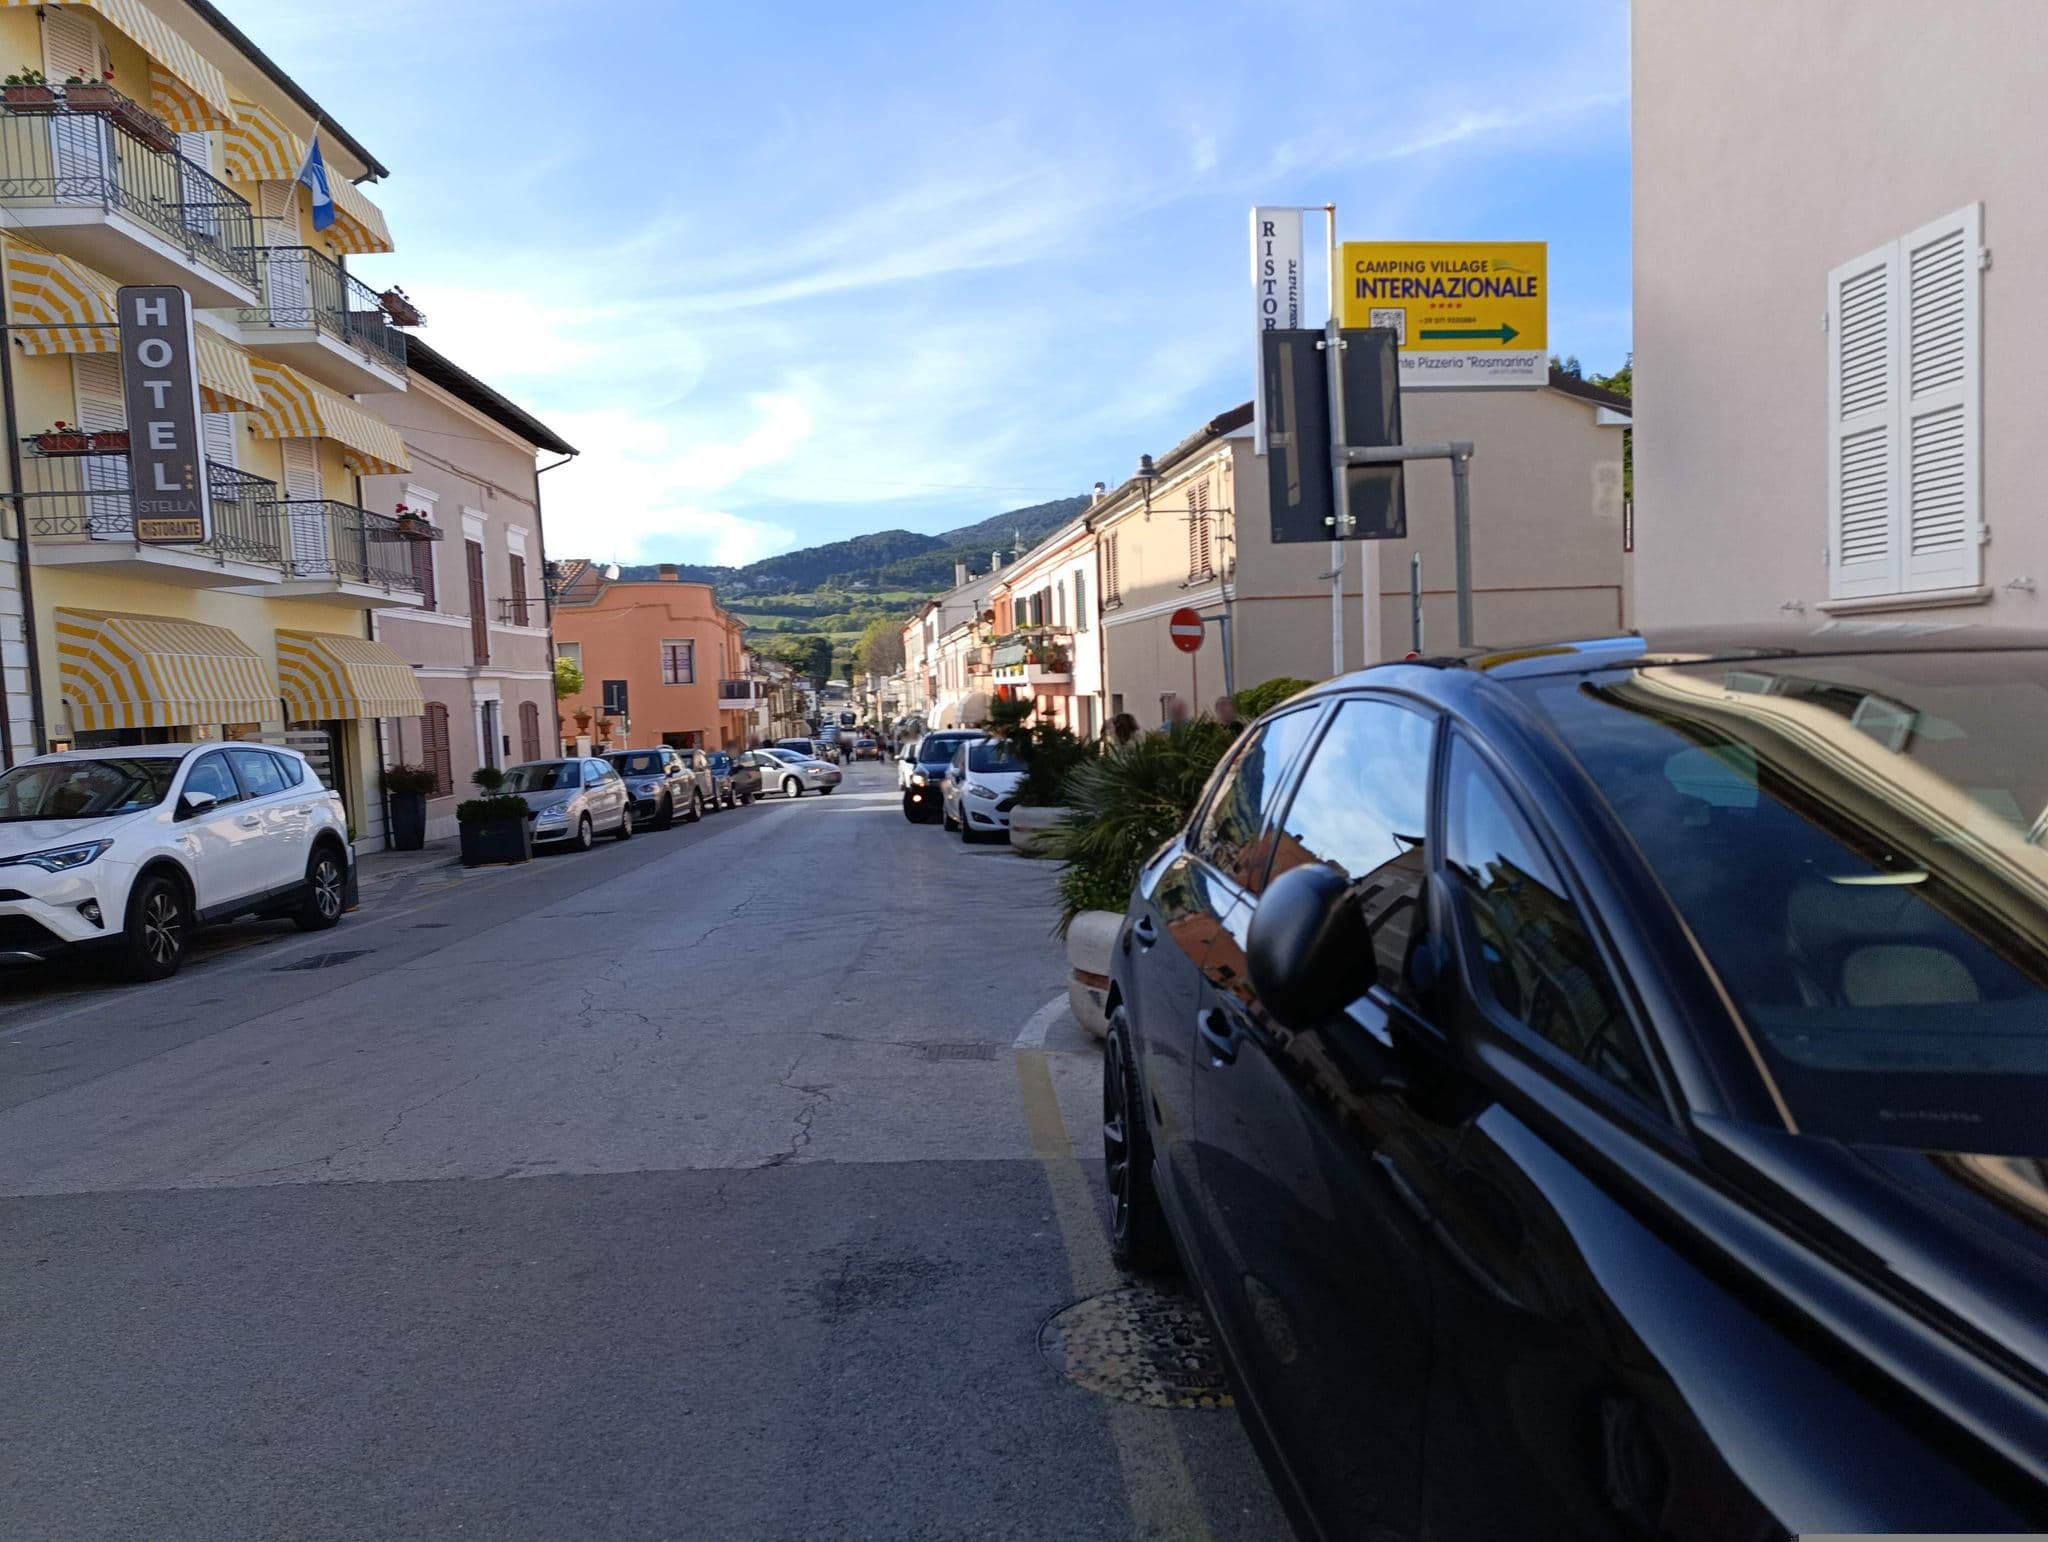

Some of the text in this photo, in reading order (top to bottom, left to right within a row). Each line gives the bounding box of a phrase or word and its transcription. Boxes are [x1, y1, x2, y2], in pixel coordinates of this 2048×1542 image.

[1355, 259, 1488, 274] CAMPING VILLAGE
[1355, 276, 1538, 299] INTERNAZIONALE
[1418, 356, 1464, 369] Pizzeria
[135, 297, 181, 491] HOTEL
[138, 500, 198, 513] STELLA
[142, 521, 200, 536] RISTORANTE
